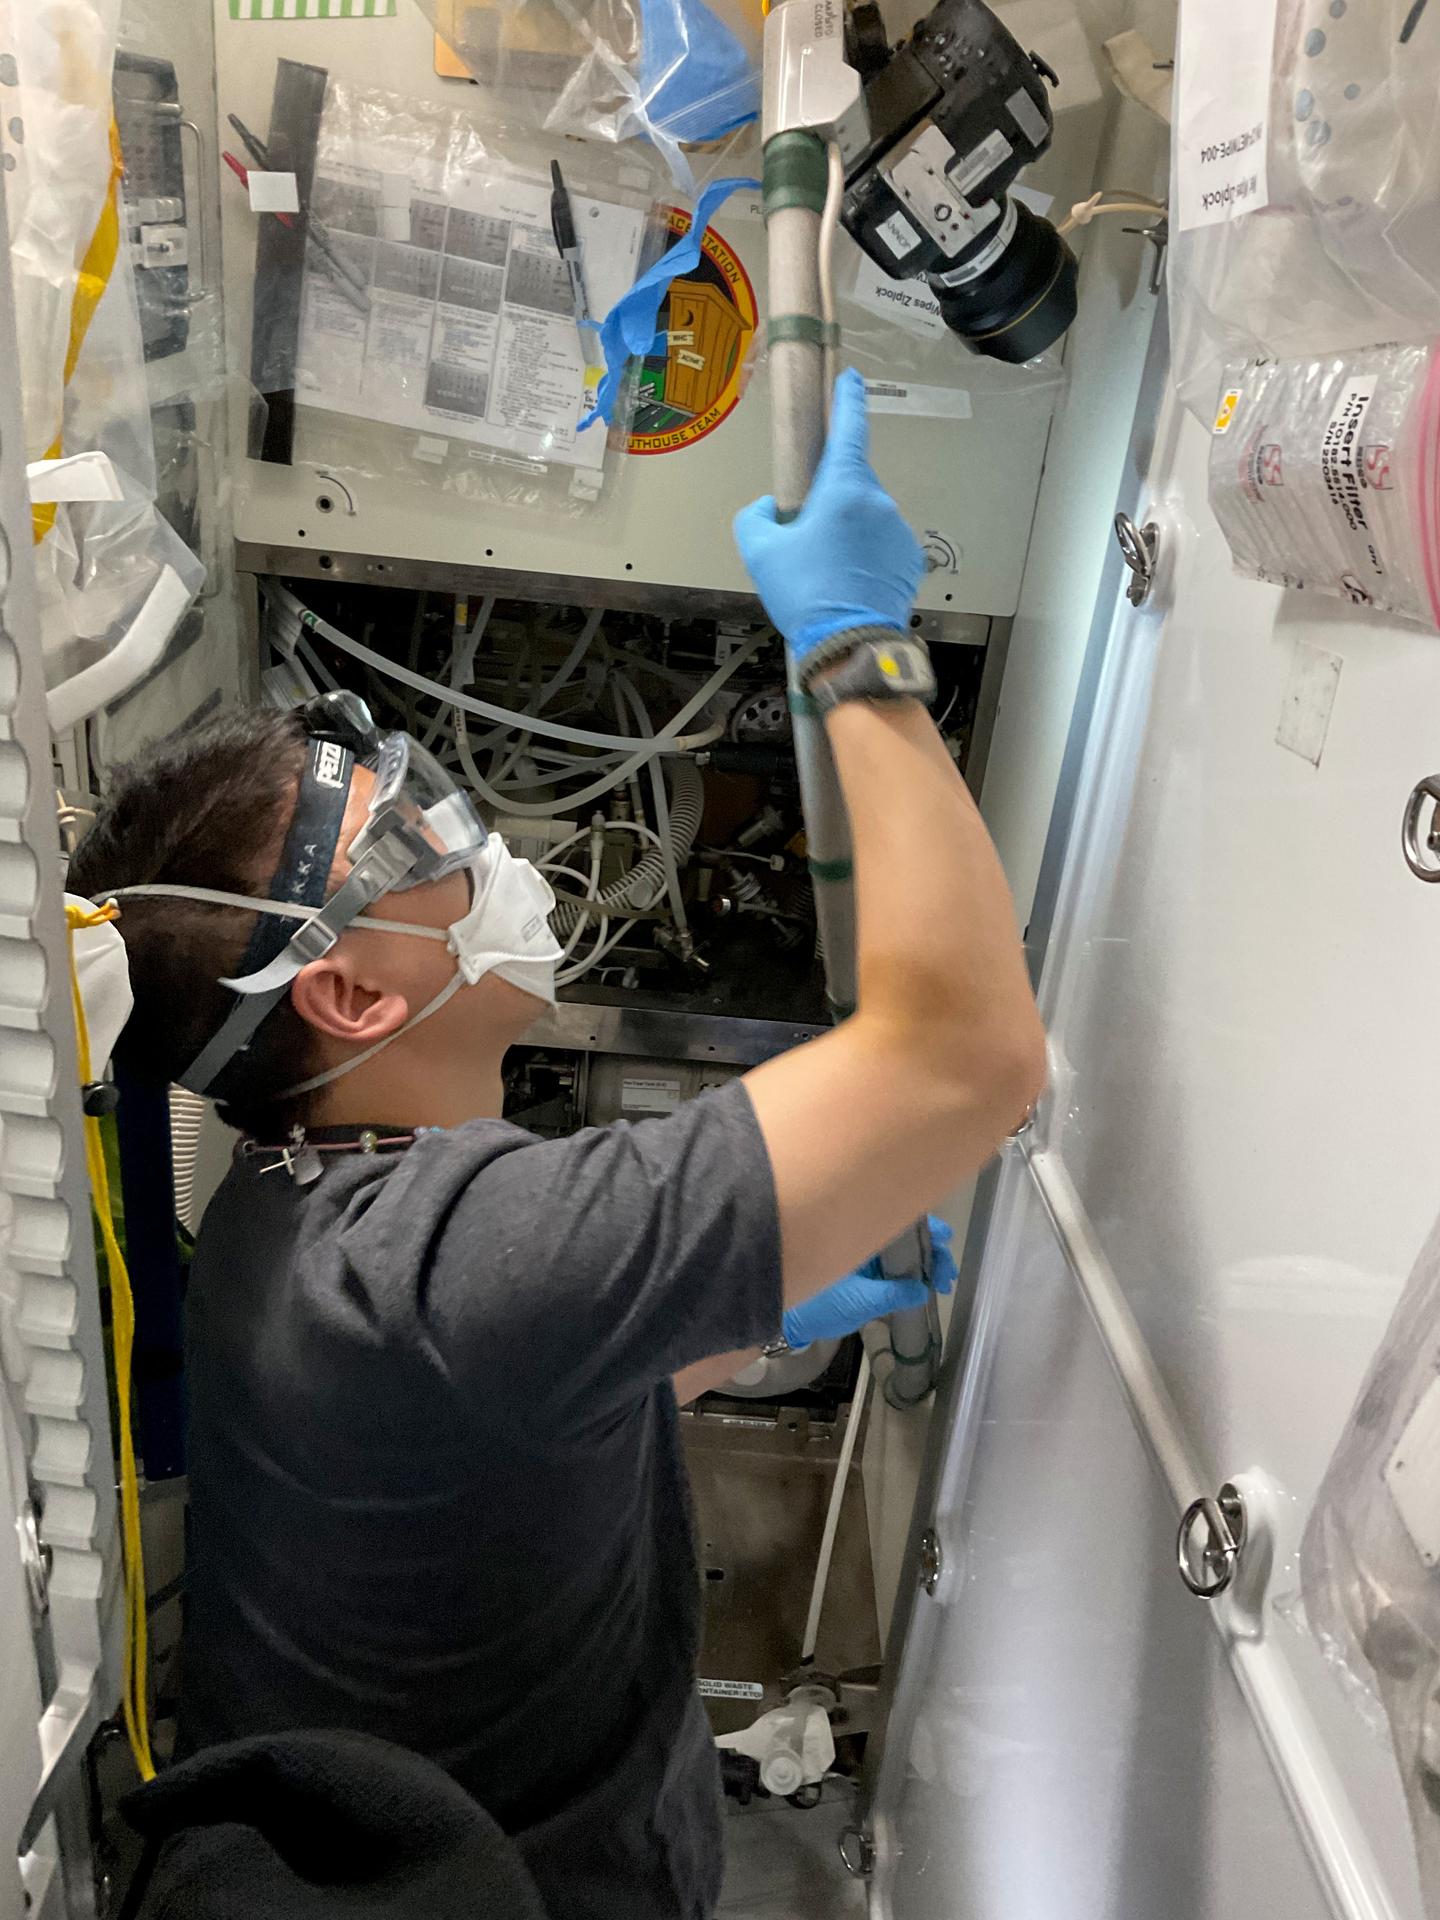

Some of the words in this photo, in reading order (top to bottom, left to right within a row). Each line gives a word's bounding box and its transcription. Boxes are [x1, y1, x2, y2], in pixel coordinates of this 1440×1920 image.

[702, 230, 740, 284] STATION
[875, 286, 912, 308] Ziplock
[1342, 393, 1357, 417] P/N
[628, 430, 689, 448] UTHOUSE
[691, 407, 721, 436] TEAM
[1324, 421, 1337, 446] S/N
[1340, 396, 1369, 465] Insert
[1342, 472, 1369, 531] Filter
[724, 1682, 753, 1690] WASTE
